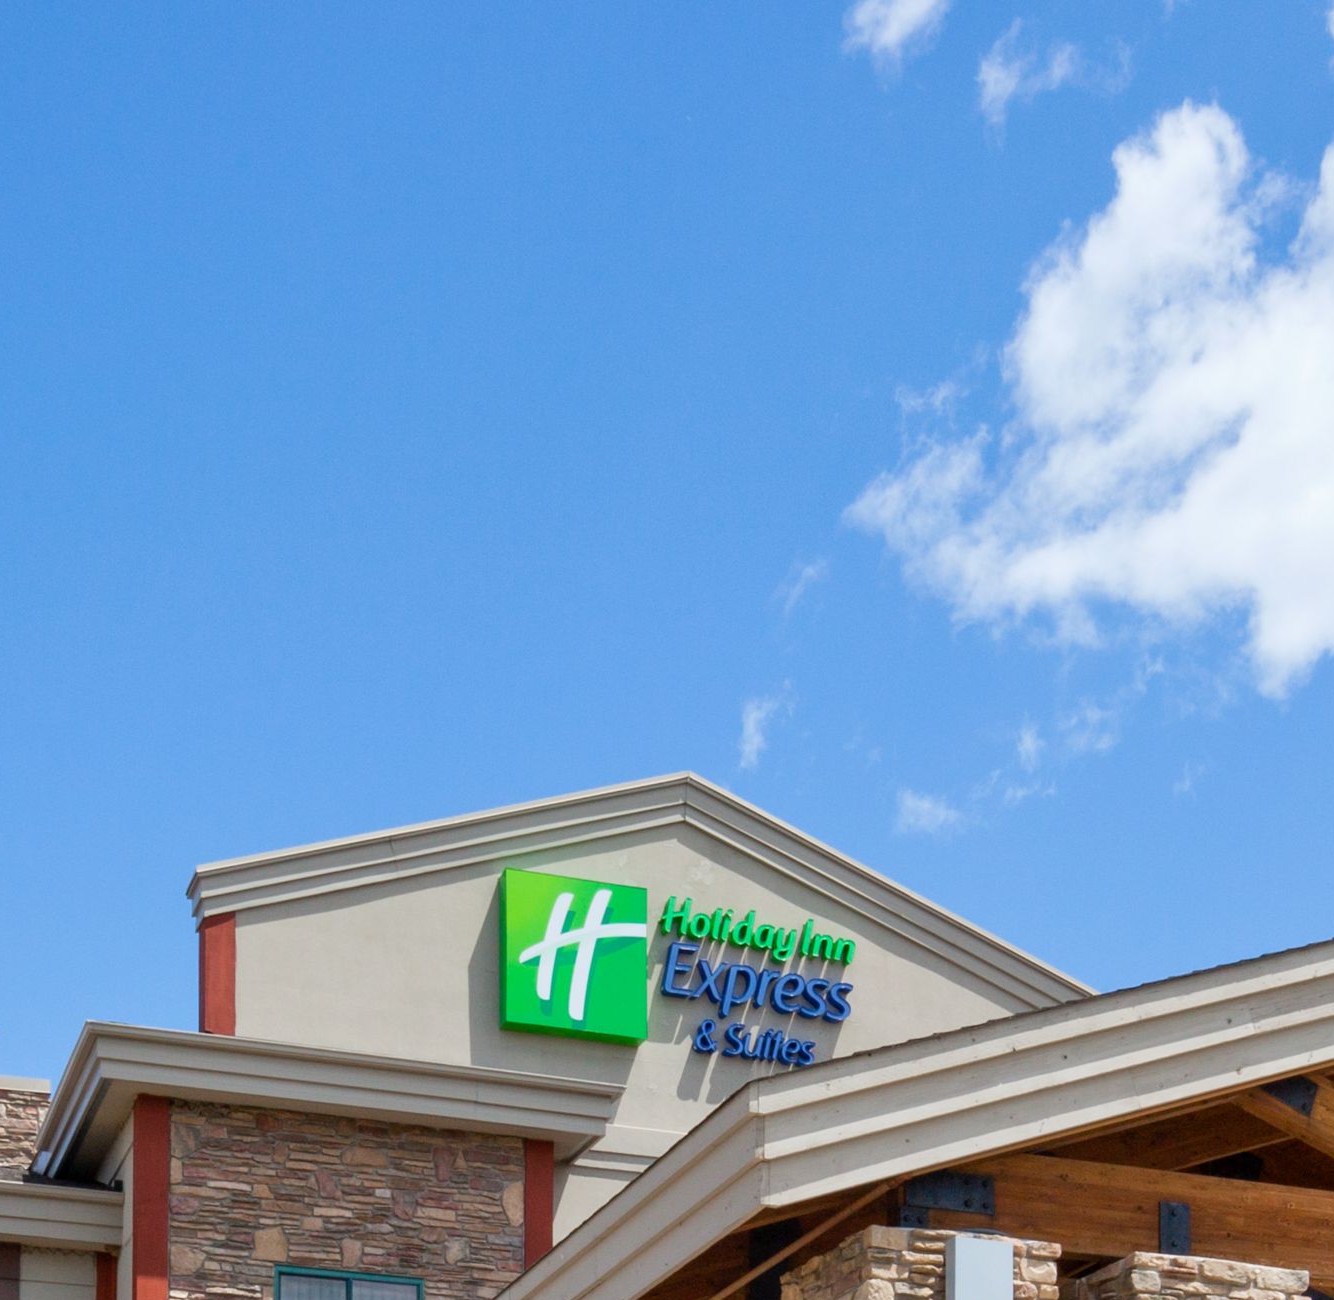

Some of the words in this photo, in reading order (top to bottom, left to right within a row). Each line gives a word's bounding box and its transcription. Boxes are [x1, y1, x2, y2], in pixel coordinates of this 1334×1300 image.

[659, 896, 797, 964] Holiday
[800, 919, 856, 966] Inn
[661, 942, 854, 1024] Express
[694, 1019, 718, 1054] &
[722, 1023, 815, 1066] Suites
